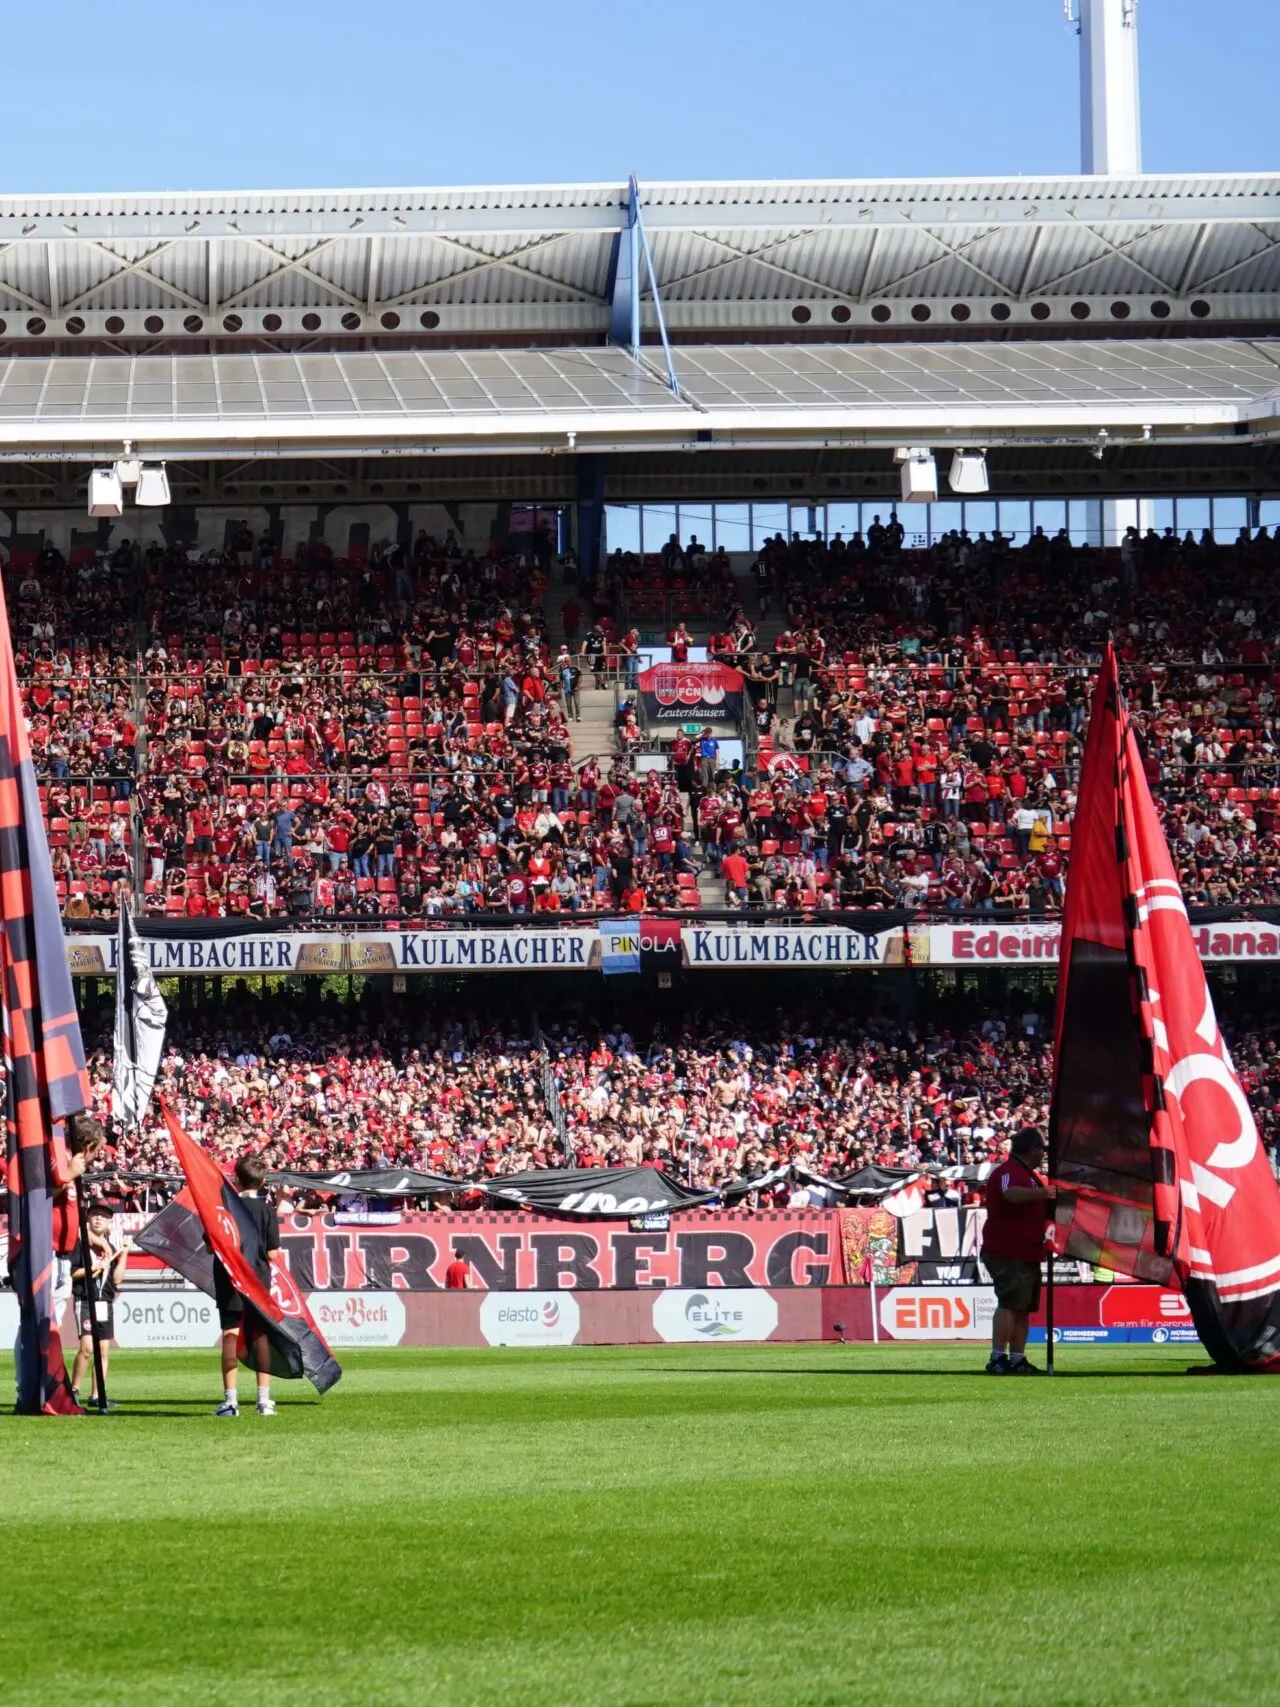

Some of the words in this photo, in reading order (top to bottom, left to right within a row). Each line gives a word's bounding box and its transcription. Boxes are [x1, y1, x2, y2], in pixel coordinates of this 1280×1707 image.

[679, 687, 702, 697] FCN
[656, 706, 727, 719] Leutershausen
[399, 934, 585, 965] KULMBACHER
[610, 936, 677, 952] PINOLA
[693, 930, 880, 962] KULMBACHER
[1193, 928, 1280, 956] Hana
[122, 1302, 164, 1324] Dent
[170, 1301, 211, 1324] One
[319, 1305, 343, 1323] Der
[346, 1297, 388, 1328] Beck
[498, 1304, 538, 1322] elasto
